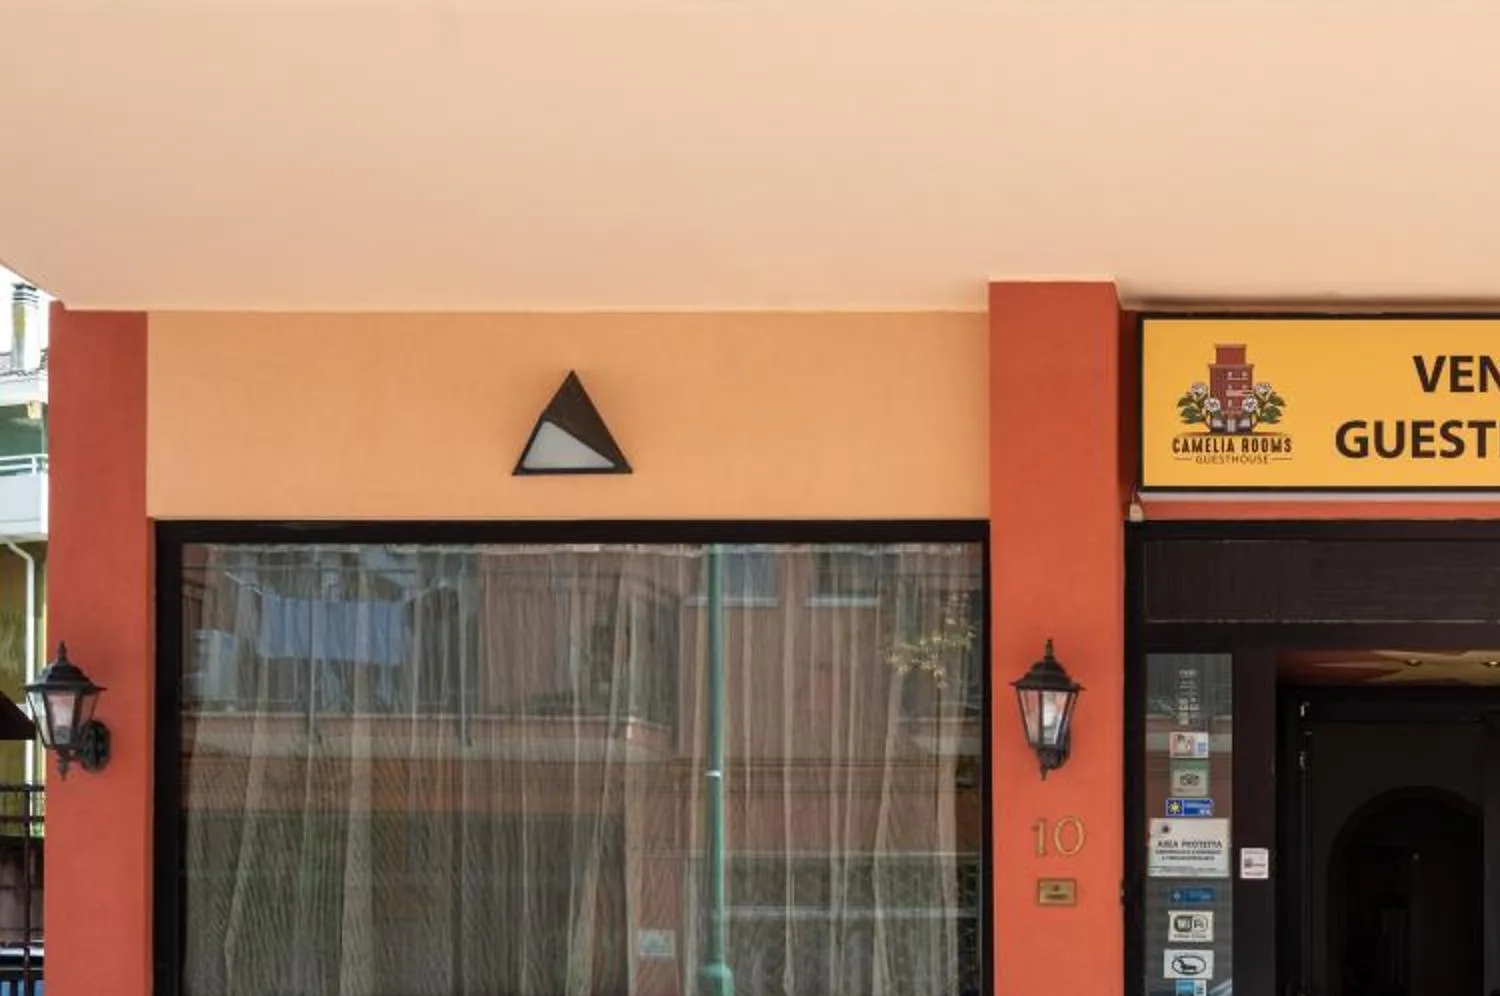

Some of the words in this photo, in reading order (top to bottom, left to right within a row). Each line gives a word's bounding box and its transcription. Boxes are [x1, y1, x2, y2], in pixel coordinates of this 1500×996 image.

[1171, 437, 1235, 453] CAMELIA
[1241, 437, 1292, 453] ROOMS
[1195, 455, 1269, 465] GUESTHOUSE
[1032, 816, 1085, 857] 10
